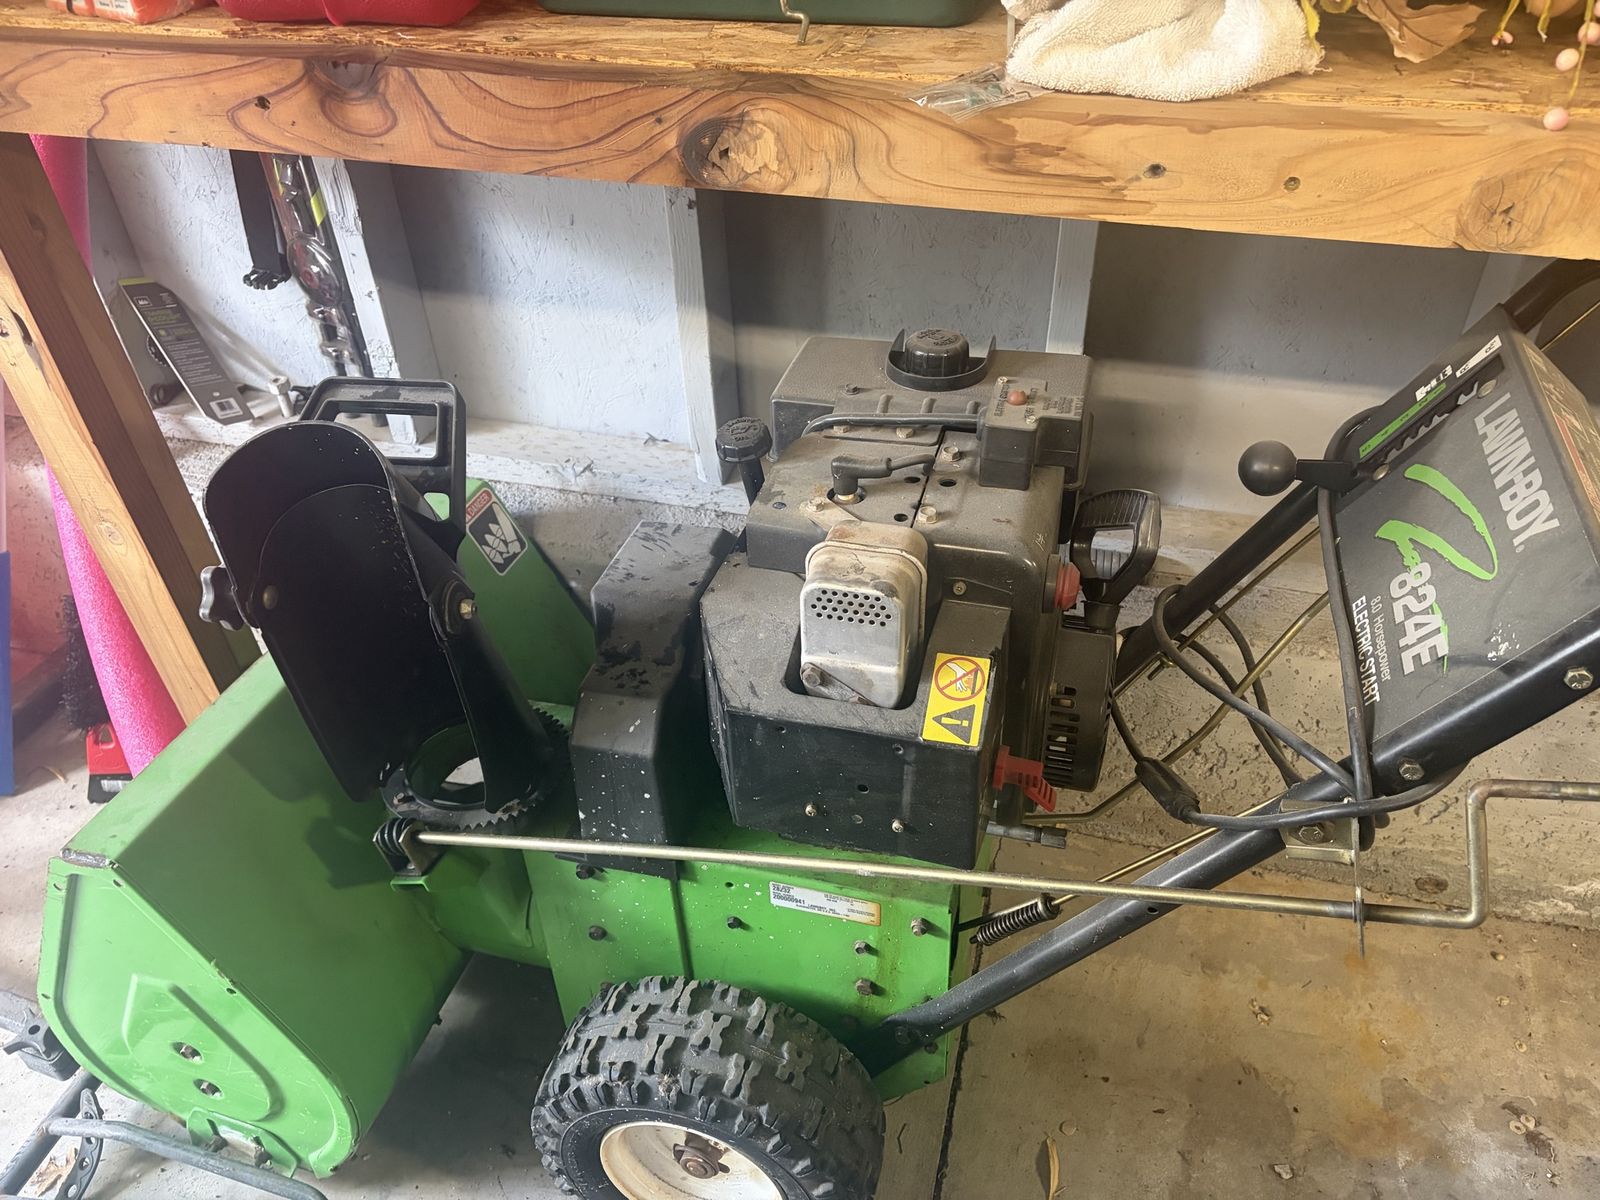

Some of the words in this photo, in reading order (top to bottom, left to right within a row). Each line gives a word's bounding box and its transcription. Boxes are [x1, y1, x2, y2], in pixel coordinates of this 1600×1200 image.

[467, 492, 490, 517] DANGER
[1352, 595, 1373, 660] ELECTRIC
[1373, 613, 1391, 682] Horsepower
[1390, 562, 1448, 675] 824E
[1359, 657, 1381, 706] START
